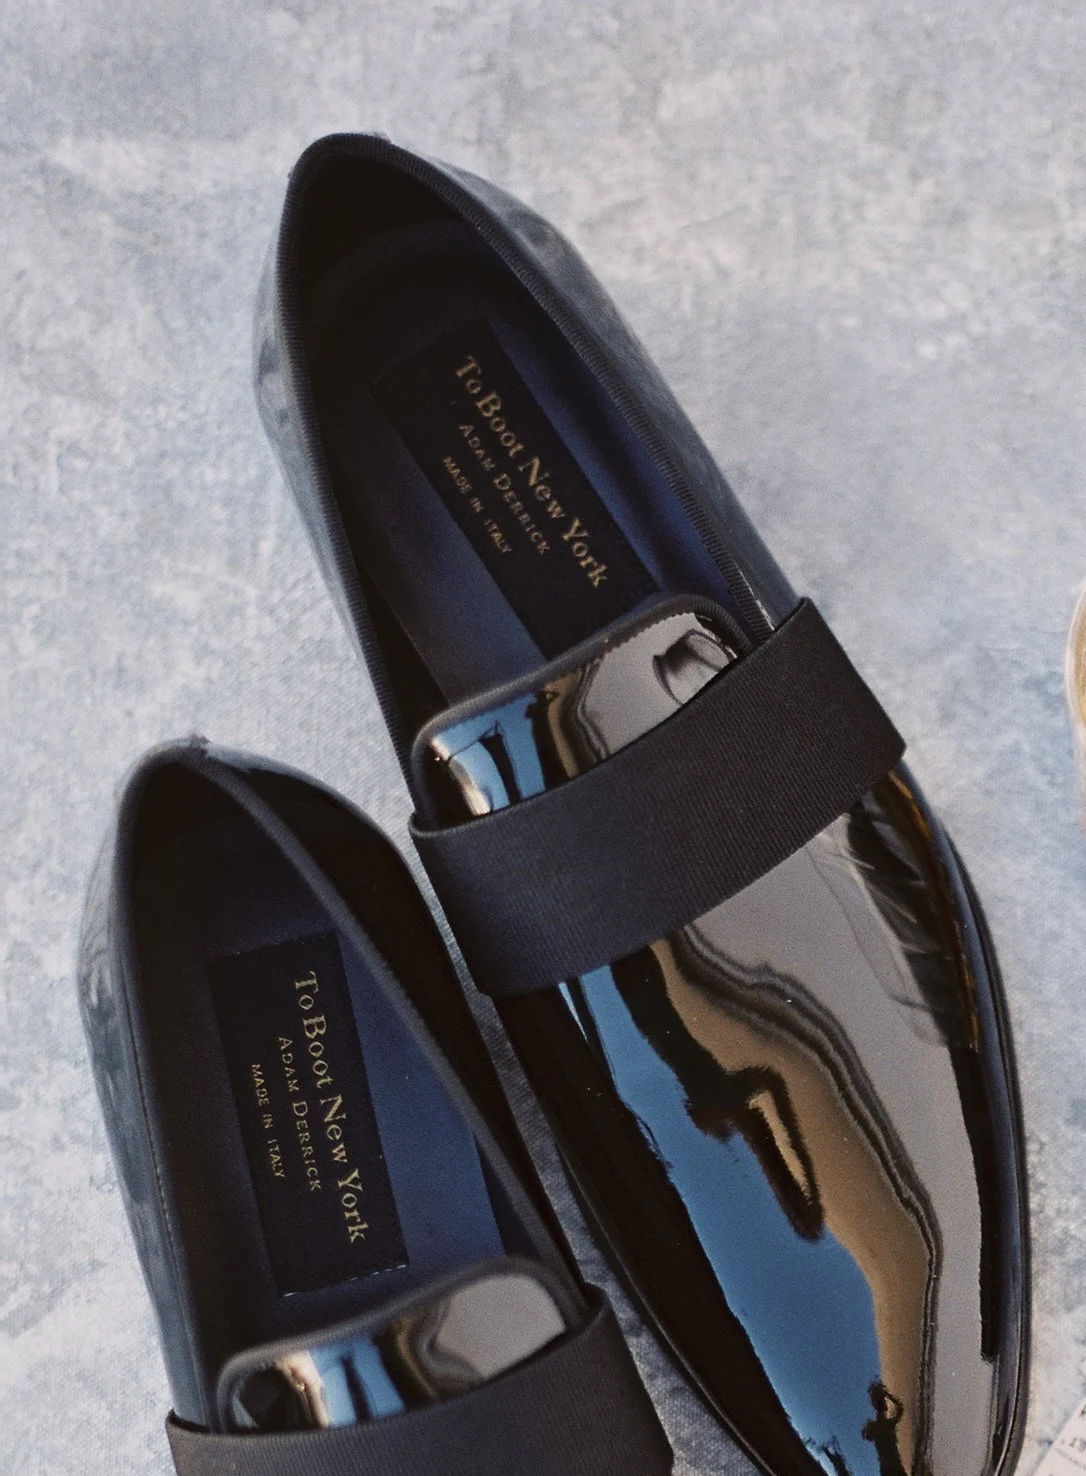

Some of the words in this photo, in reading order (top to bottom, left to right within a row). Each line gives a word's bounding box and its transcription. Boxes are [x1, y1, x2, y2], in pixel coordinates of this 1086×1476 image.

[442, 456, 472, 494] MADE
[471, 498, 484, 513] IN
[484, 519, 513, 553] ITALY
[456, 355, 482, 394] To
[476, 391, 524, 457] Boot
[518, 457, 565, 519] New
[562, 518, 608, 588] York
[294, 971, 319, 1010] To
[251, 1064, 270, 1106] MADE
[302, 1014, 334, 1089] Boot
[262, 1114, 273, 1129] IN
[320, 1094, 348, 1164] New
[267, 1139, 285, 1179] ITALY
[337, 1168, 368, 1244] York
